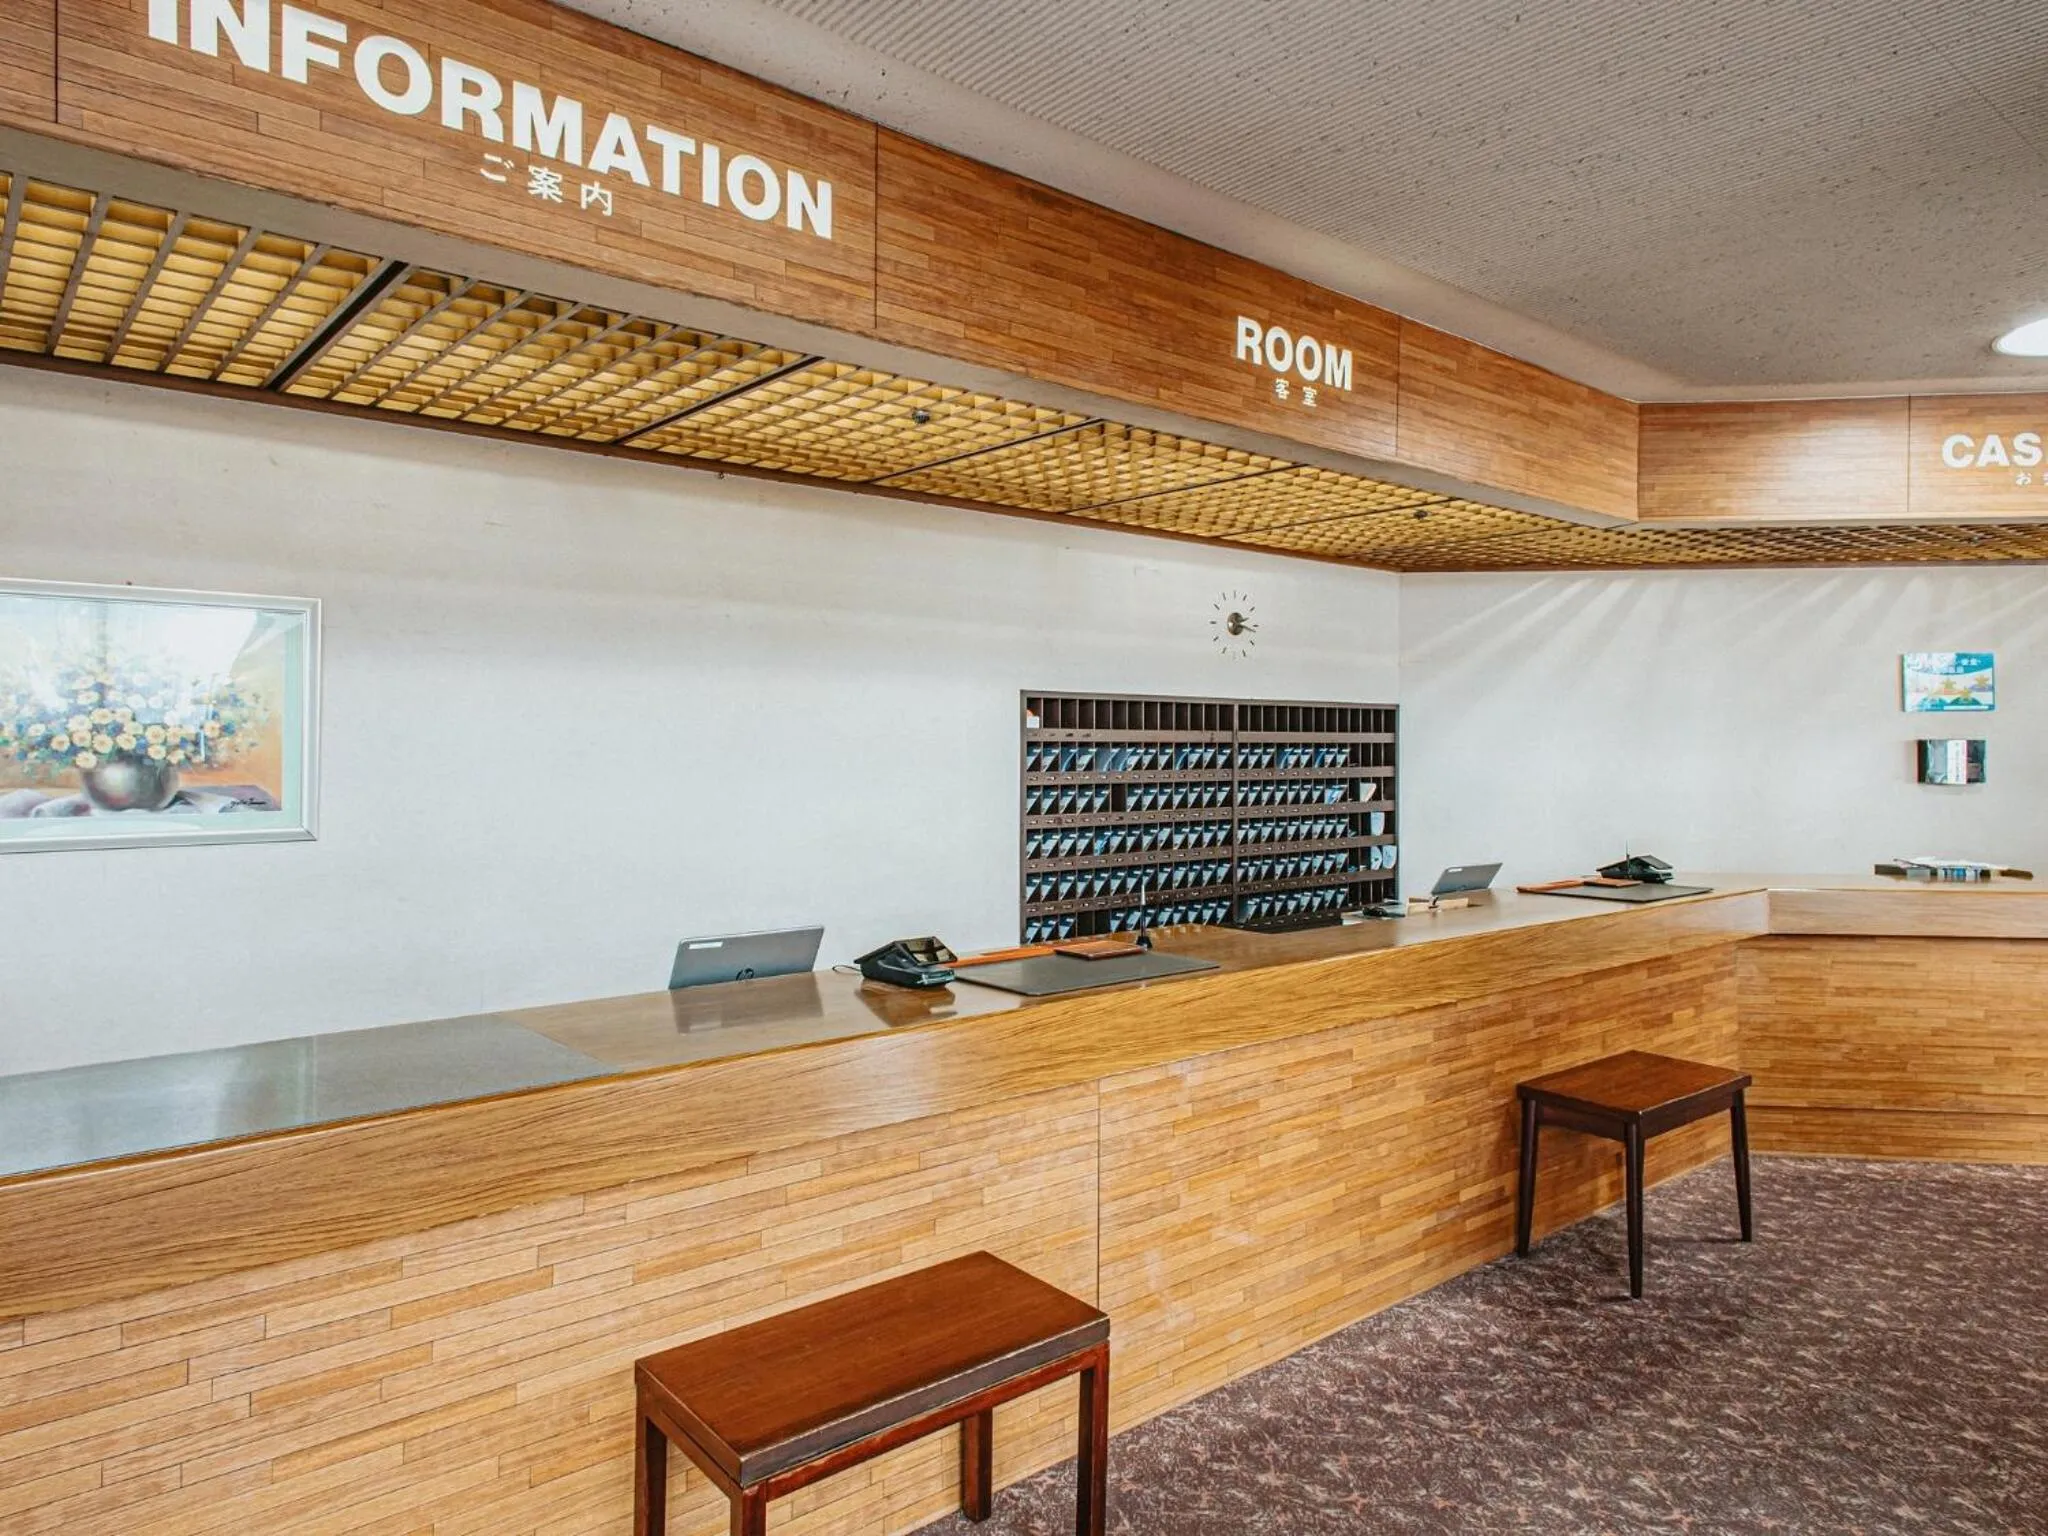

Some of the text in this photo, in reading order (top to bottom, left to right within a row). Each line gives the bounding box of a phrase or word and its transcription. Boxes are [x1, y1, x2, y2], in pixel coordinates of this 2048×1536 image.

[147, 0, 832, 240] INFORMATION
[479, 153, 613, 217] ご案内
[1237, 315, 1353, 392] ROOM
[1275, 378, 1318, 408] 客室
[1942, 432, 2048, 469] CAS
[2015, 471, 2048, 487] お
